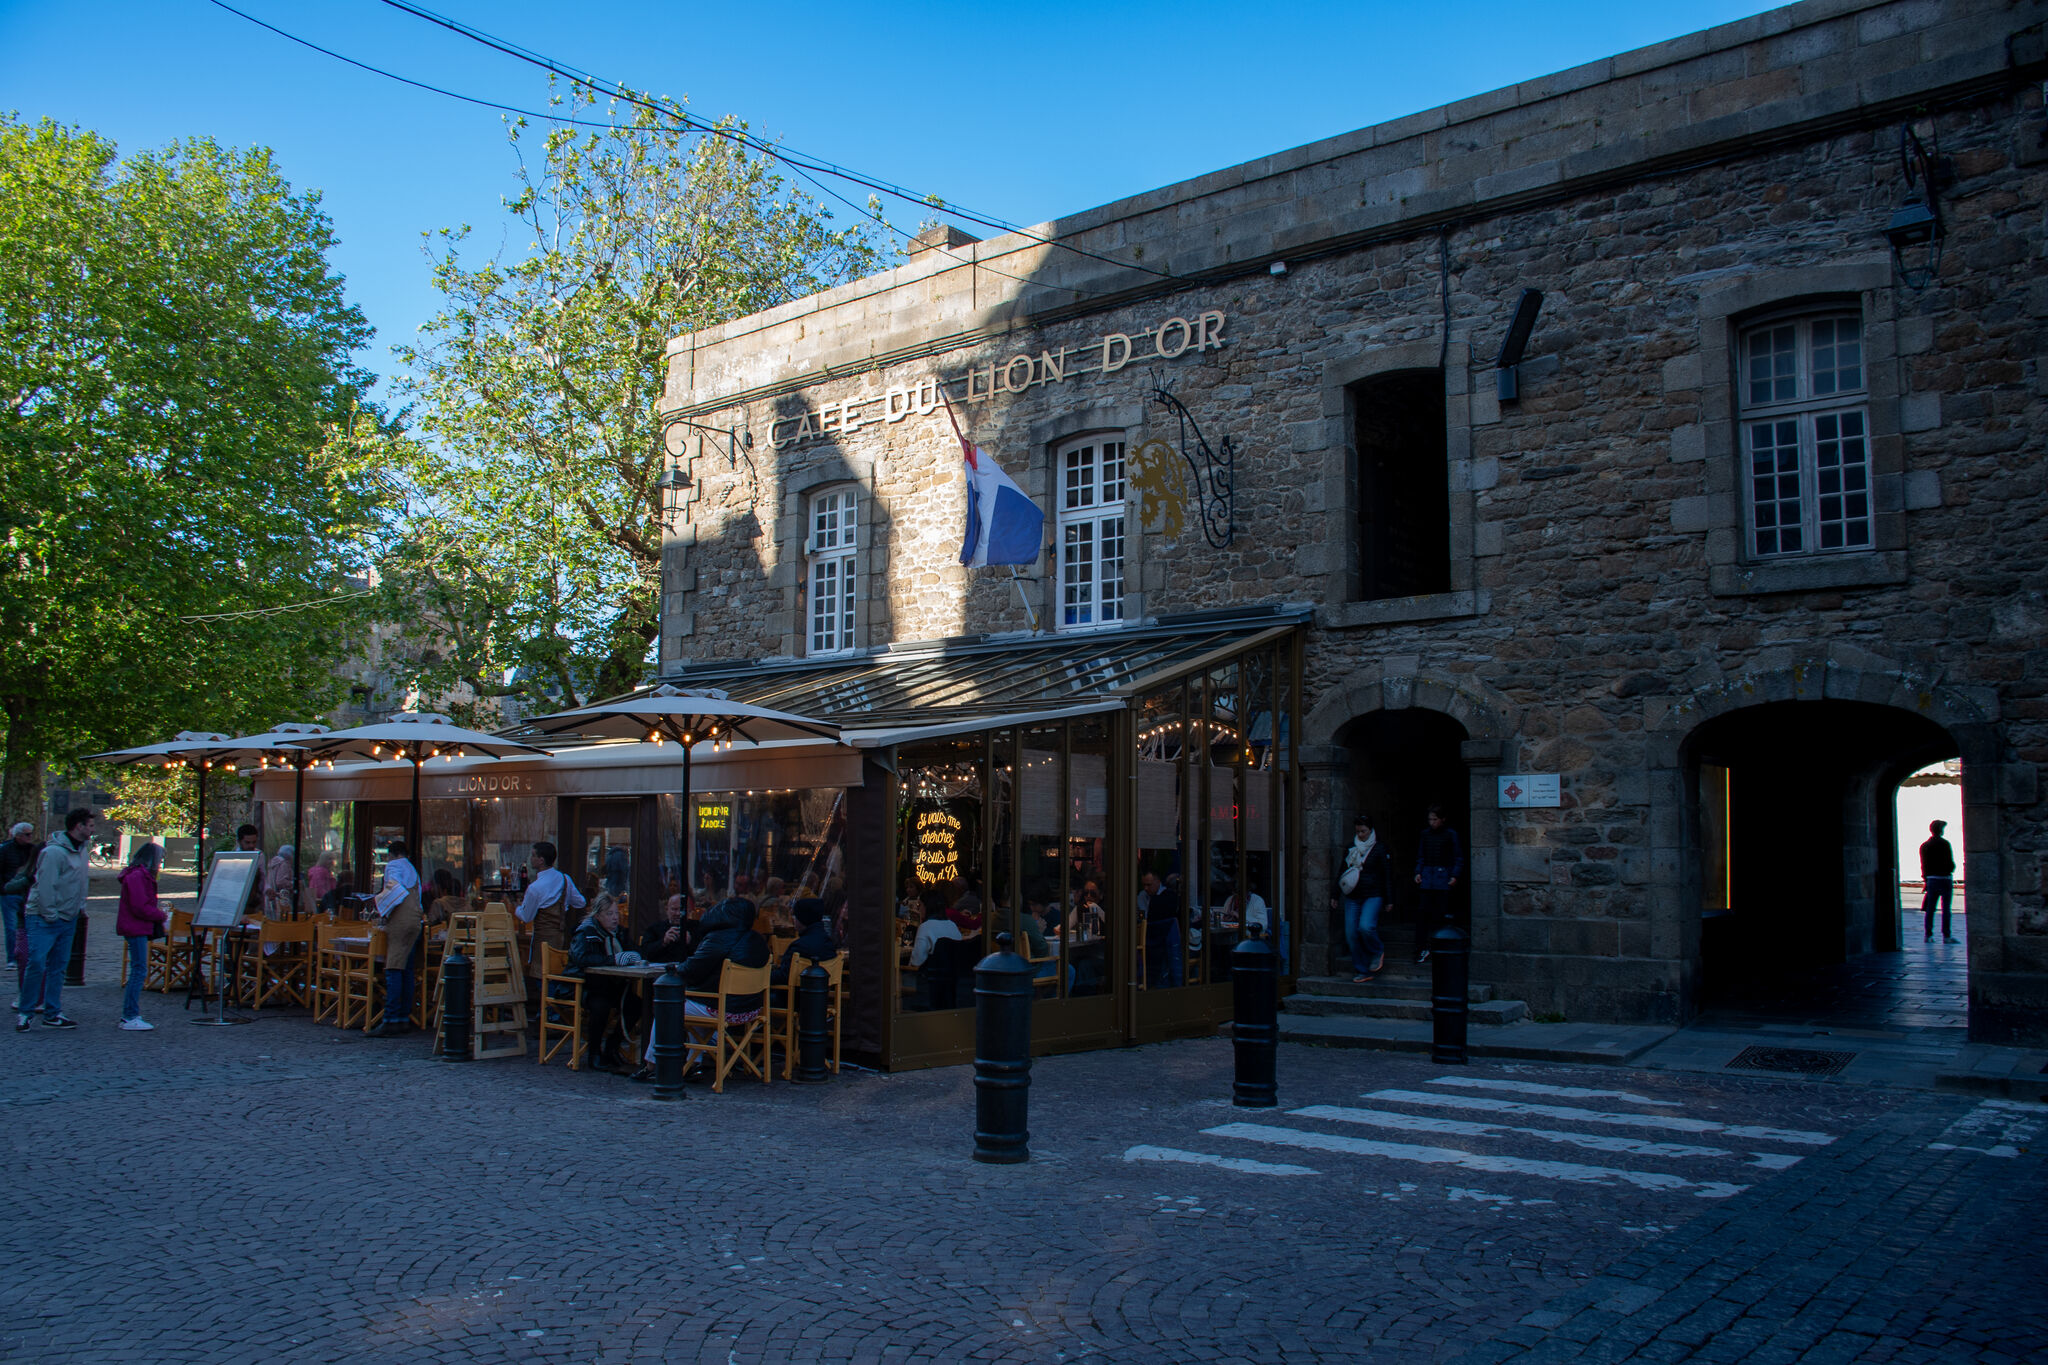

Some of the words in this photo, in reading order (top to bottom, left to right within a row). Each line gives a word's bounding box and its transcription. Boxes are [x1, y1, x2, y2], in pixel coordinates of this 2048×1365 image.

[885, 379, 938, 423] DU
[967, 346, 1065, 403] LION
[1102, 310, 1226, 373] D'OR
[458, 776, 487, 792] LION
[489, 775, 520, 791] D'OR
[917, 813, 927, 830] Si
[928, 812, 946, 825] vous
[947, 815, 961, 830] me
[921, 829, 955, 849] cherchez
[927, 850, 946, 864] suis
[946, 851, 959, 863] au
[916, 863, 936, 884] Lion
